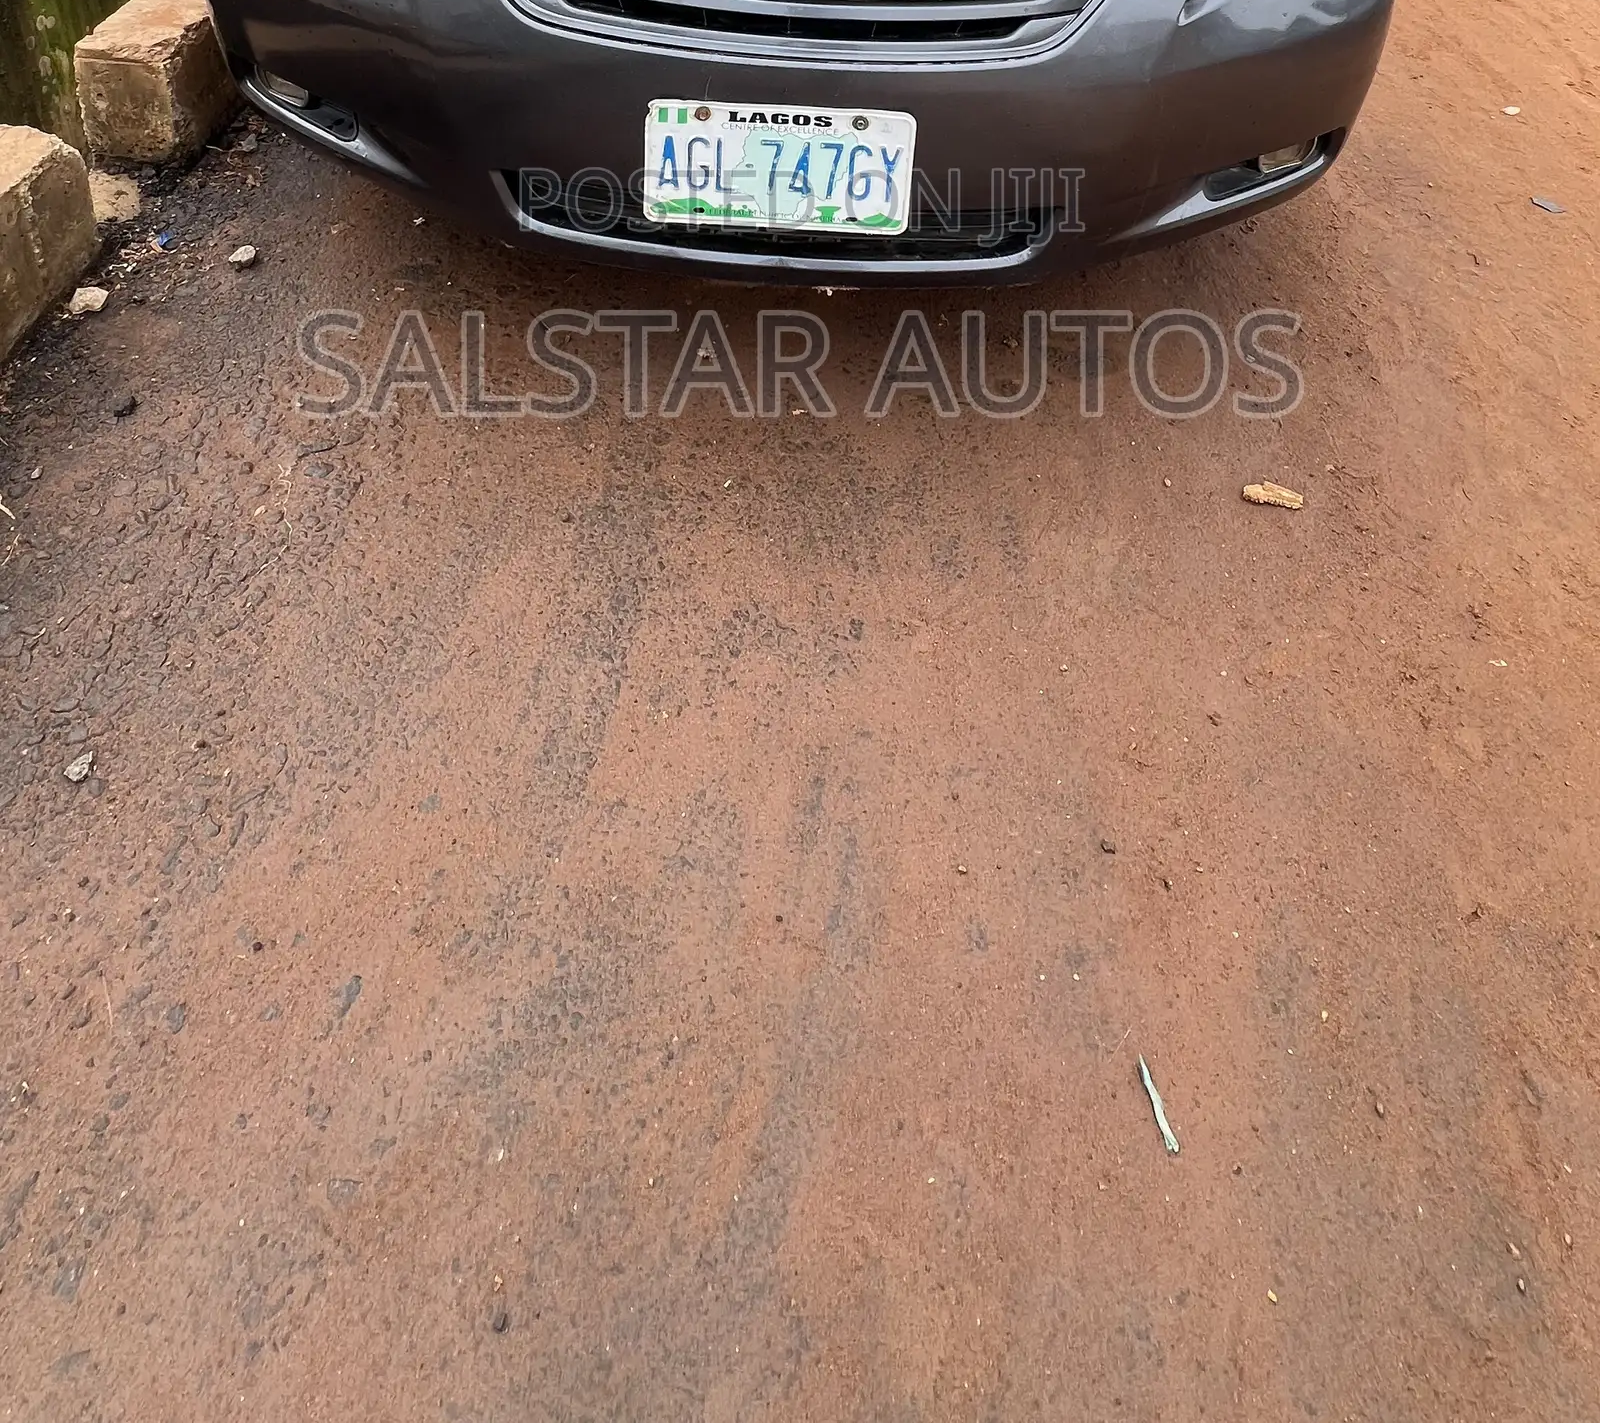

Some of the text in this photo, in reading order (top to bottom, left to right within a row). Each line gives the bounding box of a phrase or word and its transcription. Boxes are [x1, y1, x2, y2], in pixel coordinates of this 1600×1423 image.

[728, 111, 833, 128] LAGOS
[720, 122, 760, 132] CENTRE
[777, 125, 839, 136] EXCELLENCE
[658, 135, 905, 203] AGL 747GY
